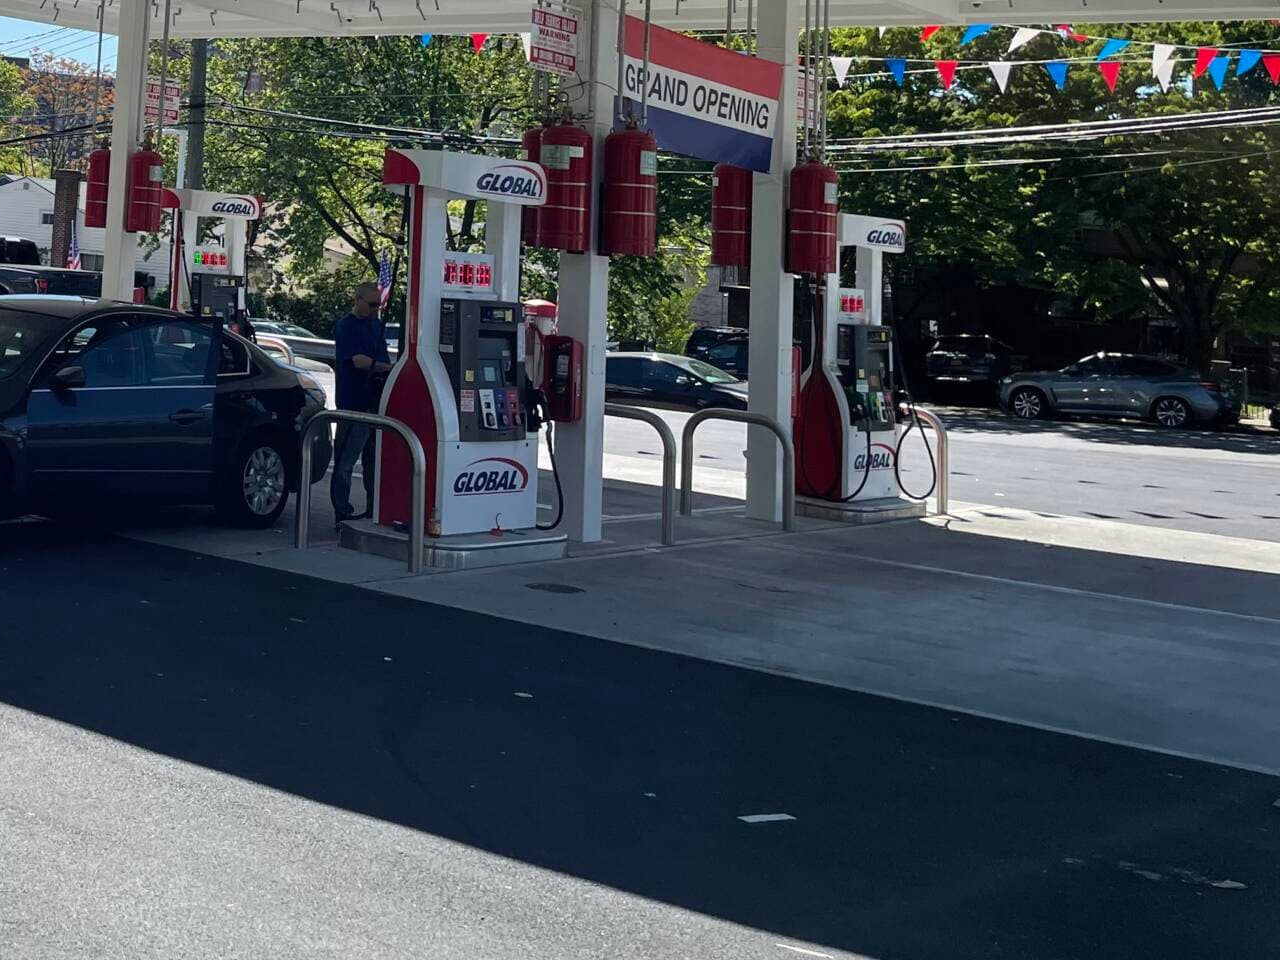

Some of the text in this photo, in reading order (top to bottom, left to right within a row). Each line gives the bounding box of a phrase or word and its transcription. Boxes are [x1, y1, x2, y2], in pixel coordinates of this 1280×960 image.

[539, 28, 570, 41] WARNING
[693, 85, 770, 130] OPENING
[476, 172, 538, 197] GLOBAL
[211, 201, 252, 215] GLOBAL
[453, 470, 518, 493] GLOBAL
